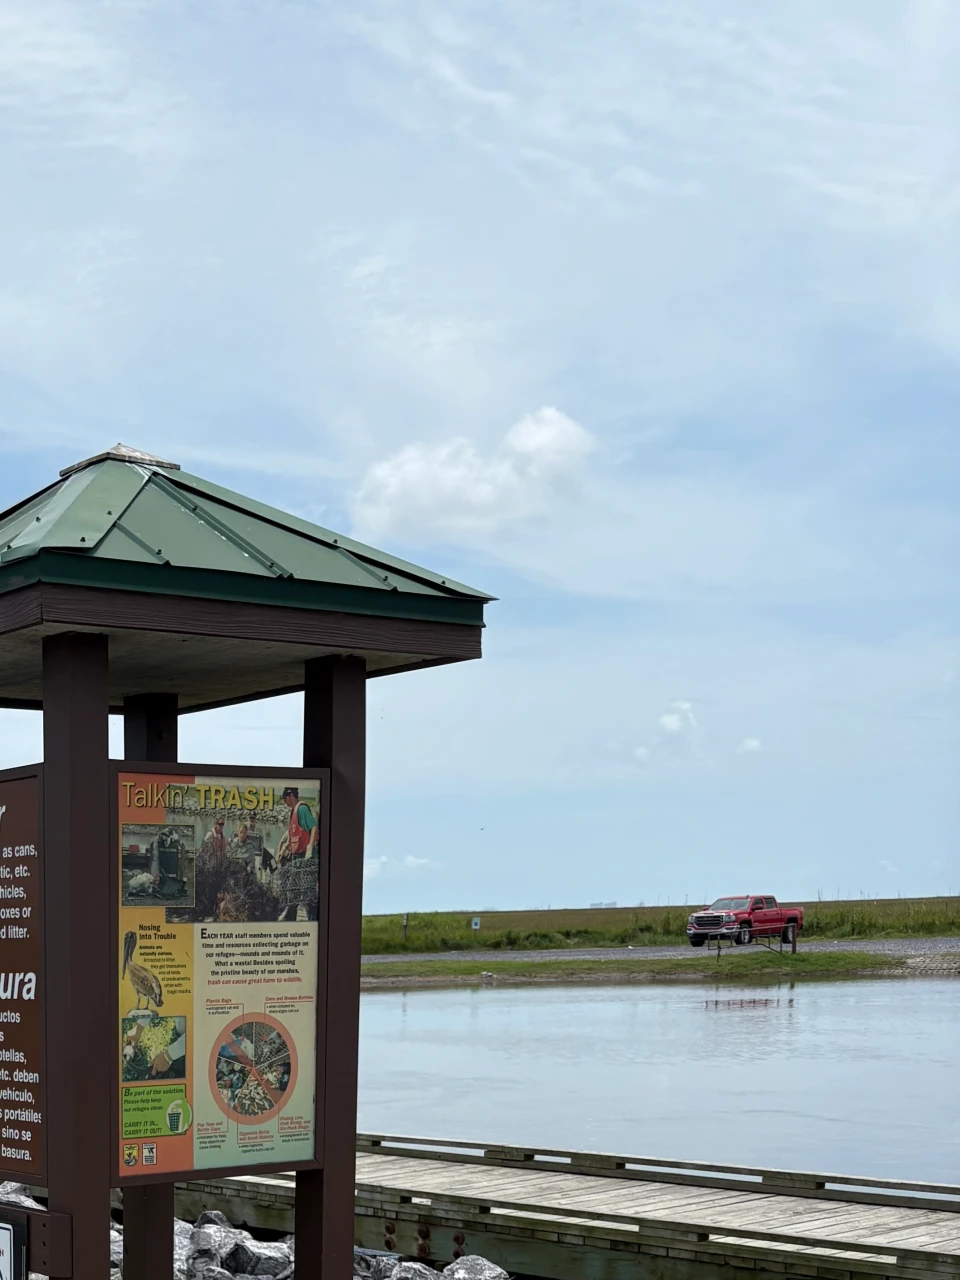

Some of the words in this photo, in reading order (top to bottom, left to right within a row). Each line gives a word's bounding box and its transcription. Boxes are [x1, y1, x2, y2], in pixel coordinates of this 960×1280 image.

[196, 785, 275, 811] TRASH
[2, 847, 13, 858] as
[14, 844, 38, 858] cans,
[14, 865, 30, 877] etc.
[22, 906, 32, 918] or
[8, 926, 30, 939] litter.
[13, 1069, 39, 1084] deben
[2, 1127, 20, 1140] sino
[21, 1130, 32, 1142] se
[1, 1144, 32, 1161] basura.
